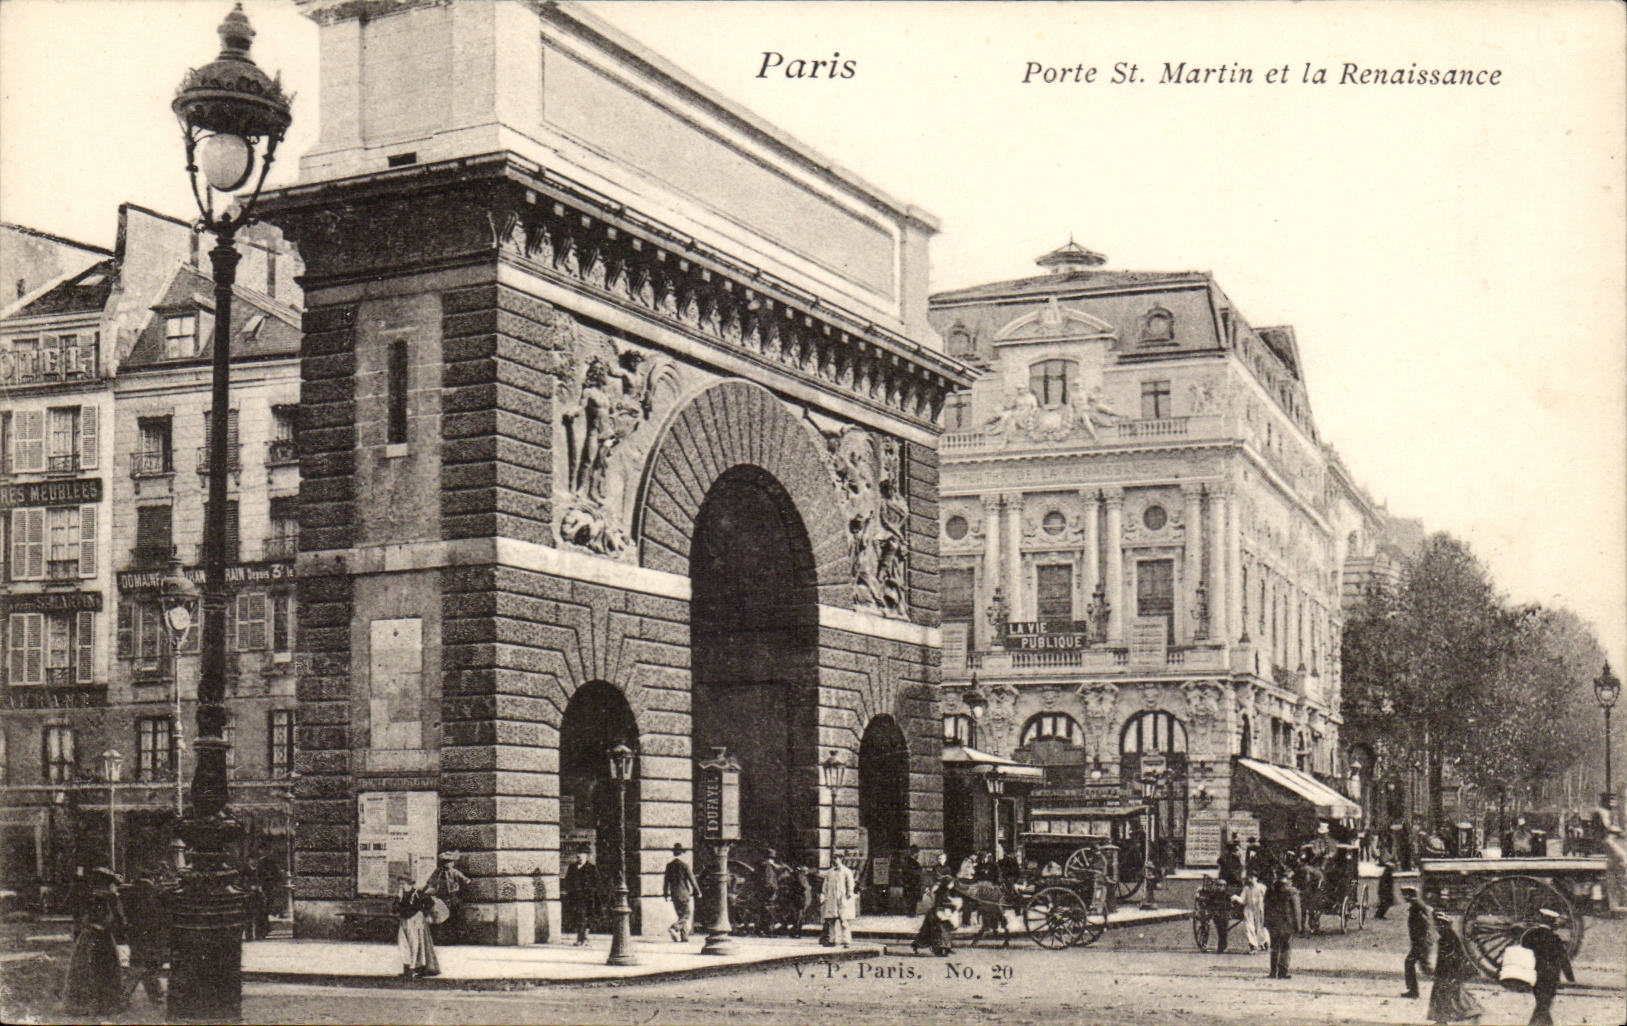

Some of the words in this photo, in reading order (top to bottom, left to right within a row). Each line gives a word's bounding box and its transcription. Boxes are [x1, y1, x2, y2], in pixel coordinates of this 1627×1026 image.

[1009, 623, 1024, 635] LA
[1027, 621, 1048, 634] VIE
[1021, 635, 1082, 649] PUBLIQUE
[706, 776, 719, 832] DUFAYEL
